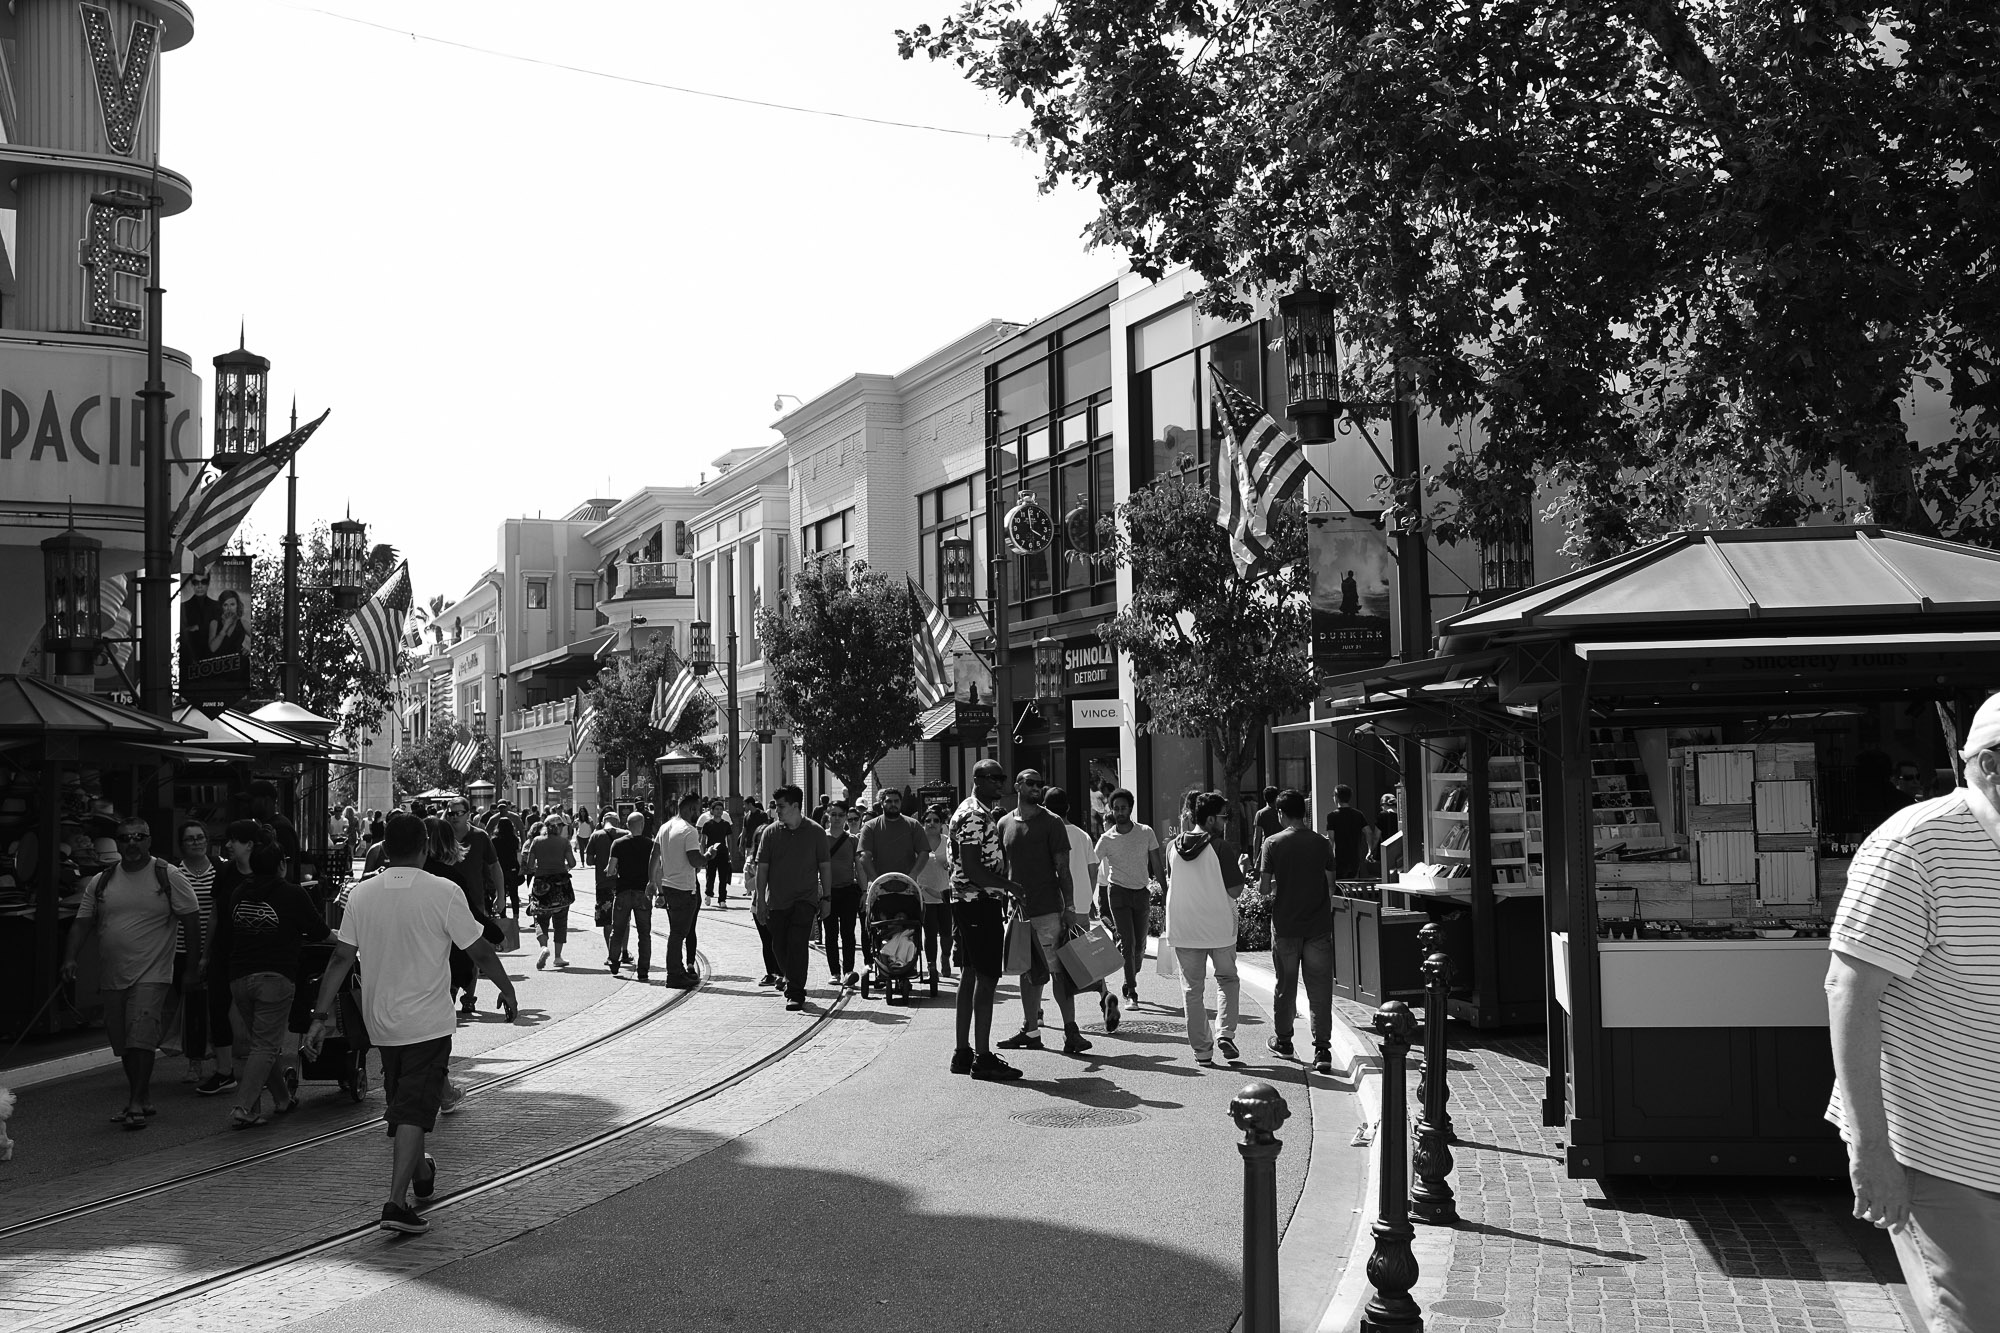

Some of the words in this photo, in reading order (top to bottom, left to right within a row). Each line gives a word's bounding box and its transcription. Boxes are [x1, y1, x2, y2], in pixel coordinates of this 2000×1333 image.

[1, 388, 190, 477] PACIFC
[1319, 630, 1383, 640] DUNKIRK
[1065, 643, 1113, 670] SHINOLA
[1742, 654, 1840, 672] Sincerely
[1850, 652, 1908, 667] Yours
[187, 656, 241, 680] HOUSE
[1074, 669, 1108, 684] DETROIT
[111, 692, 133, 705] The
